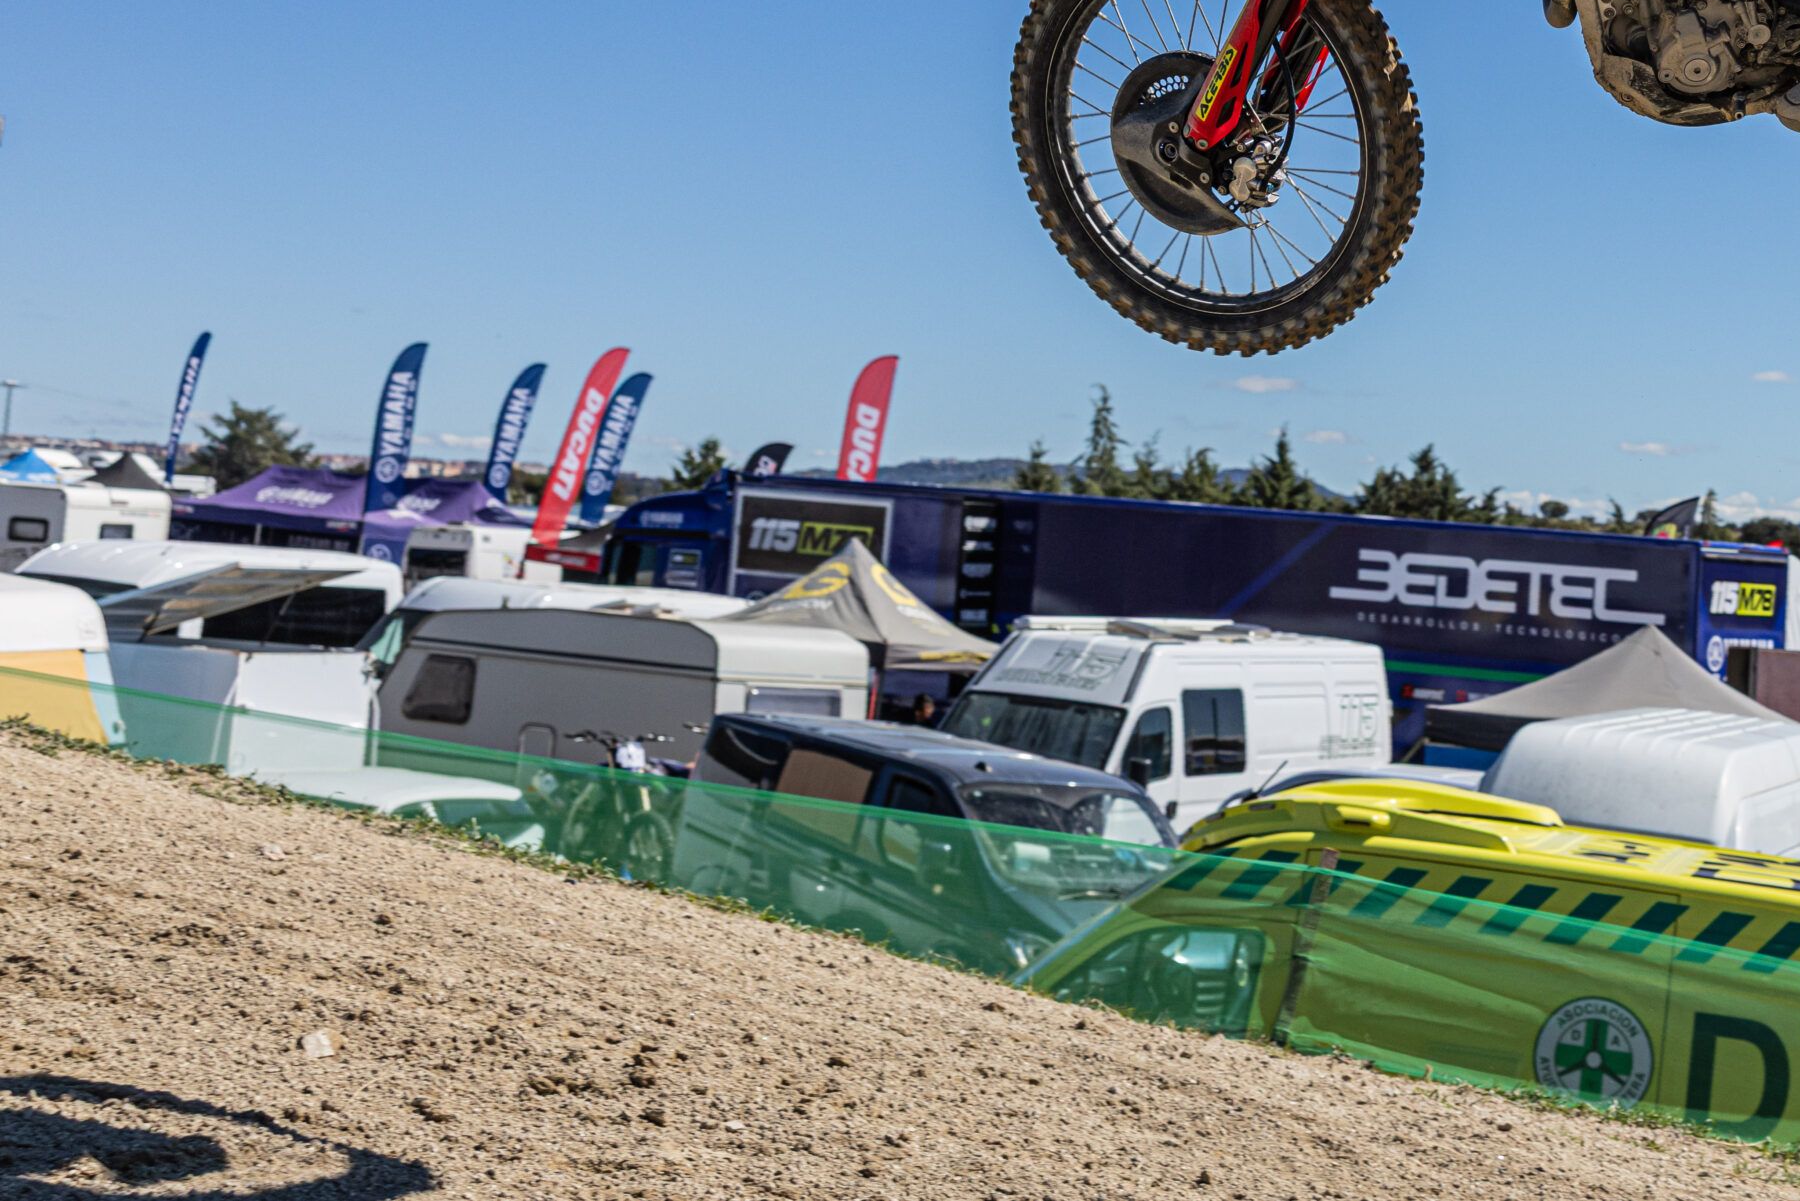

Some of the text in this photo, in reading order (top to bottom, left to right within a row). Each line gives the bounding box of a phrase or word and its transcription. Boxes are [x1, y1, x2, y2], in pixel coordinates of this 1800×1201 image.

[1199, 48, 1236, 119] ACERBIS
[379, 371, 414, 456] YAMAHA
[494, 386, 531, 464] YAMAHA
[552, 387, 606, 502] DUCATI
[593, 394, 635, 472] YAMAHA
[748, 516, 800, 552] 115
[1356, 611, 1481, 632] DESARROLLOS
[1709, 580, 1738, 615] 115
[1556, 1002, 1638, 1038] ASOCIACION
